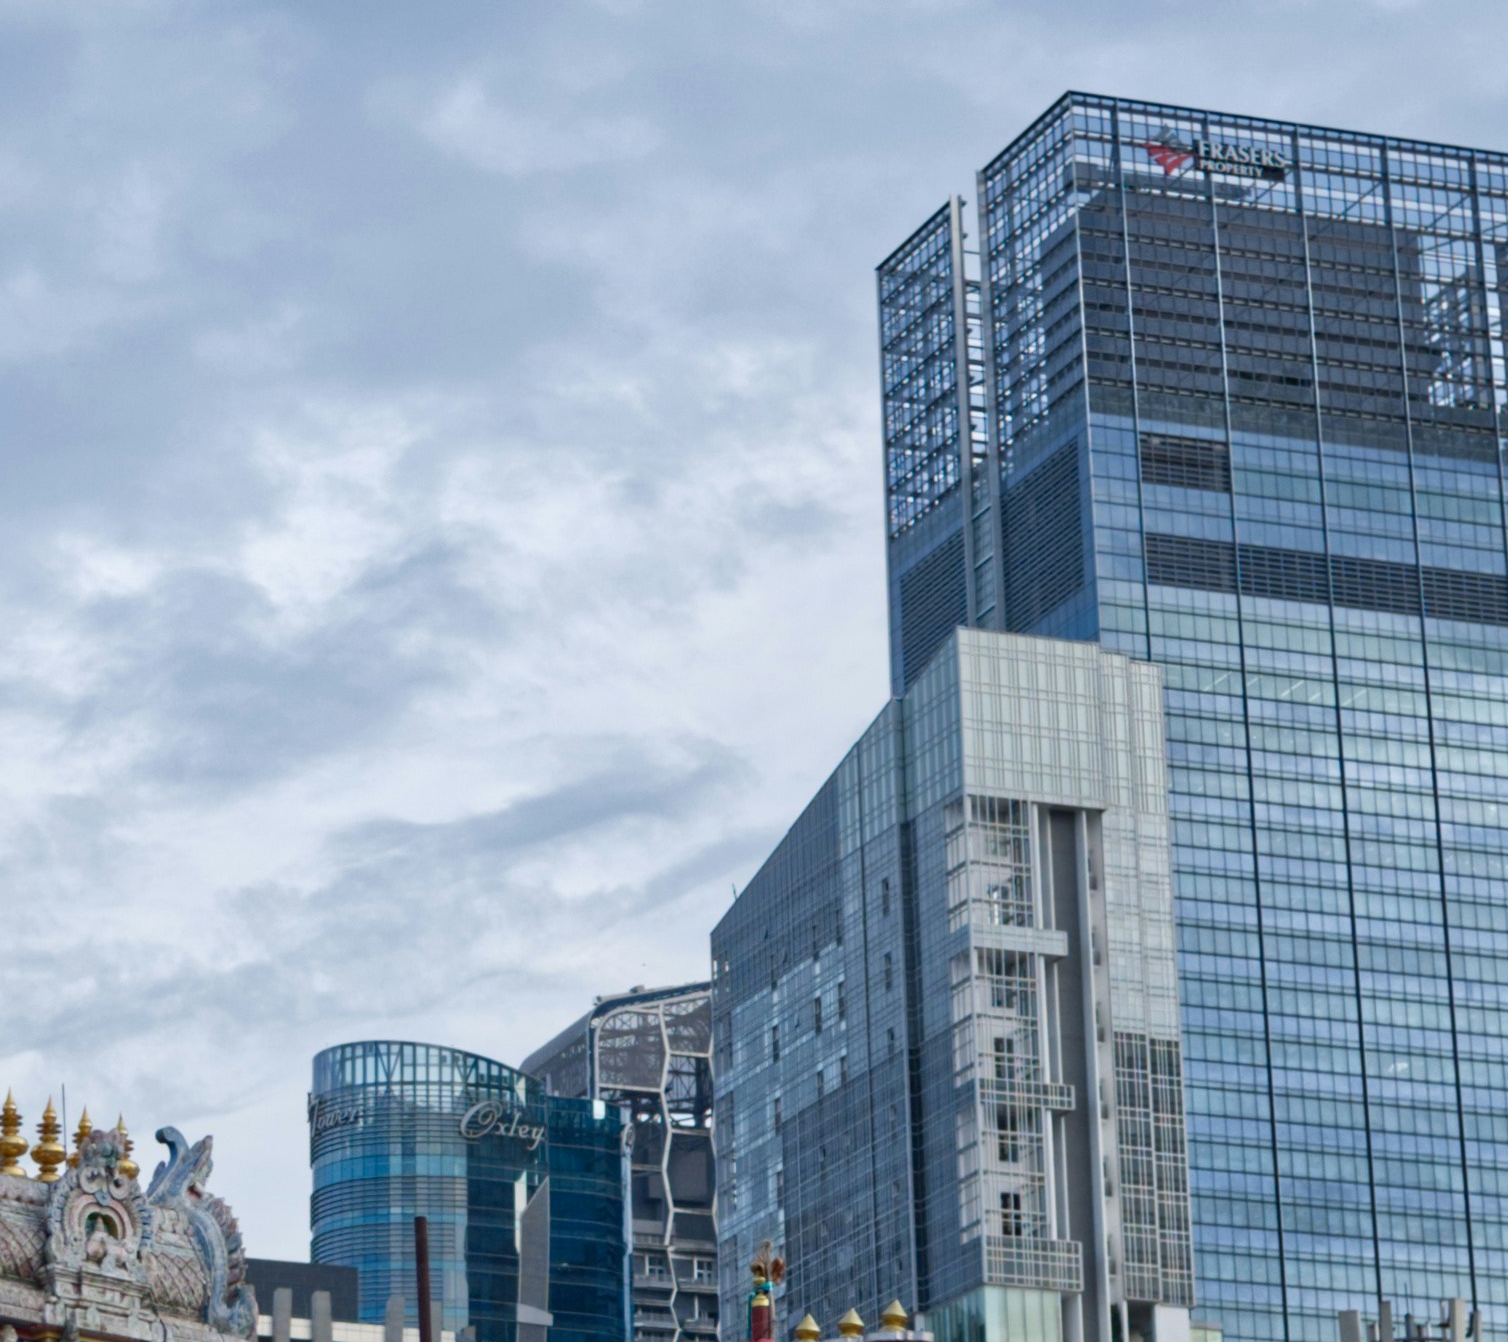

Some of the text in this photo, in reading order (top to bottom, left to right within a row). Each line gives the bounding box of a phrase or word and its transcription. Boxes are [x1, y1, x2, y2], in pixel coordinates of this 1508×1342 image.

[1198, 139, 1286, 168] FRASERS
[1199, 159, 1264, 178] PROPERTY
[459, 1100, 546, 1150] Oxley
